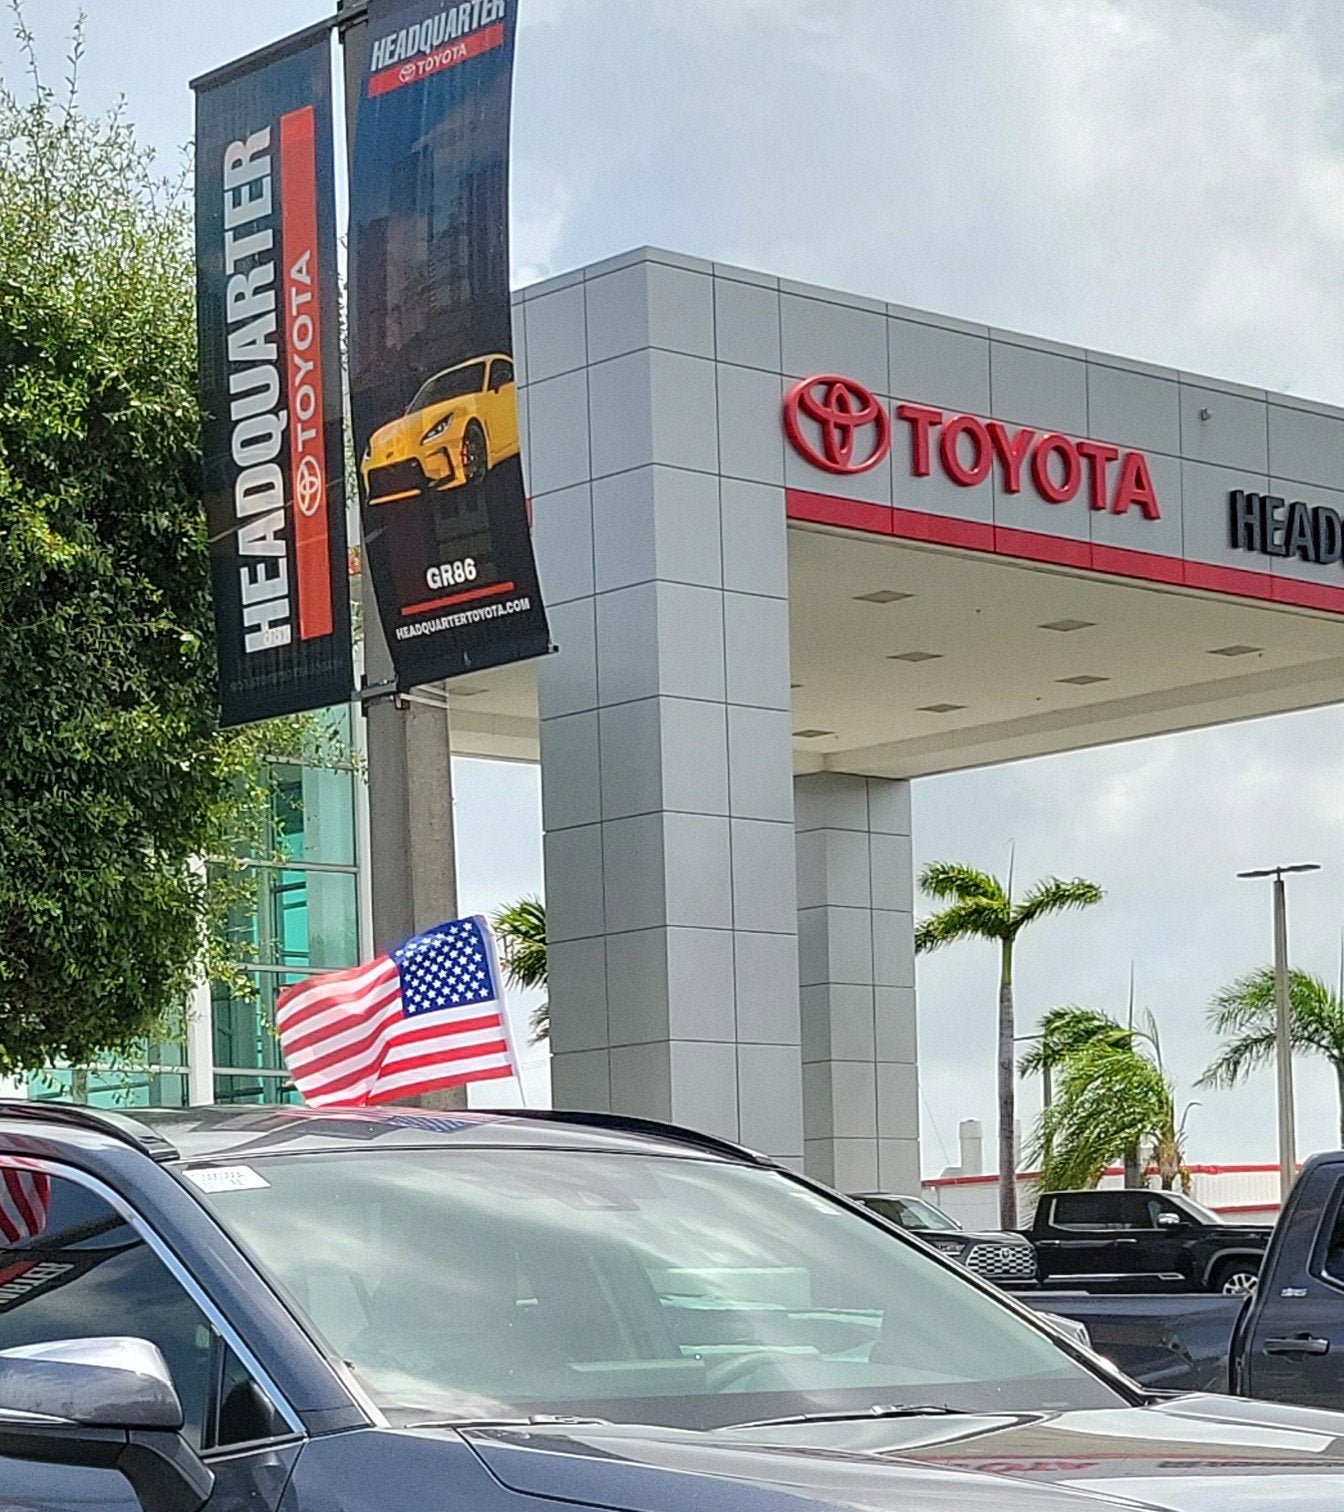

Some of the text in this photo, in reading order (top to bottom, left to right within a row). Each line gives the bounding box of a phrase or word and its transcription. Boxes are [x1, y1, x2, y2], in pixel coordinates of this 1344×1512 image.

[369, 0, 505, 72] HEADQUARTER
[418, 43, 467, 75] TOYOTA
[290, 250, 318, 452] TOYOTA
[224, 125, 292, 653] HEADQUARTER
[896, 404, 1161, 521] TOYOTA
[426, 558, 477, 590] GR86
[395, 597, 531, 640] HEADQUARTERTOYOTA.COM
